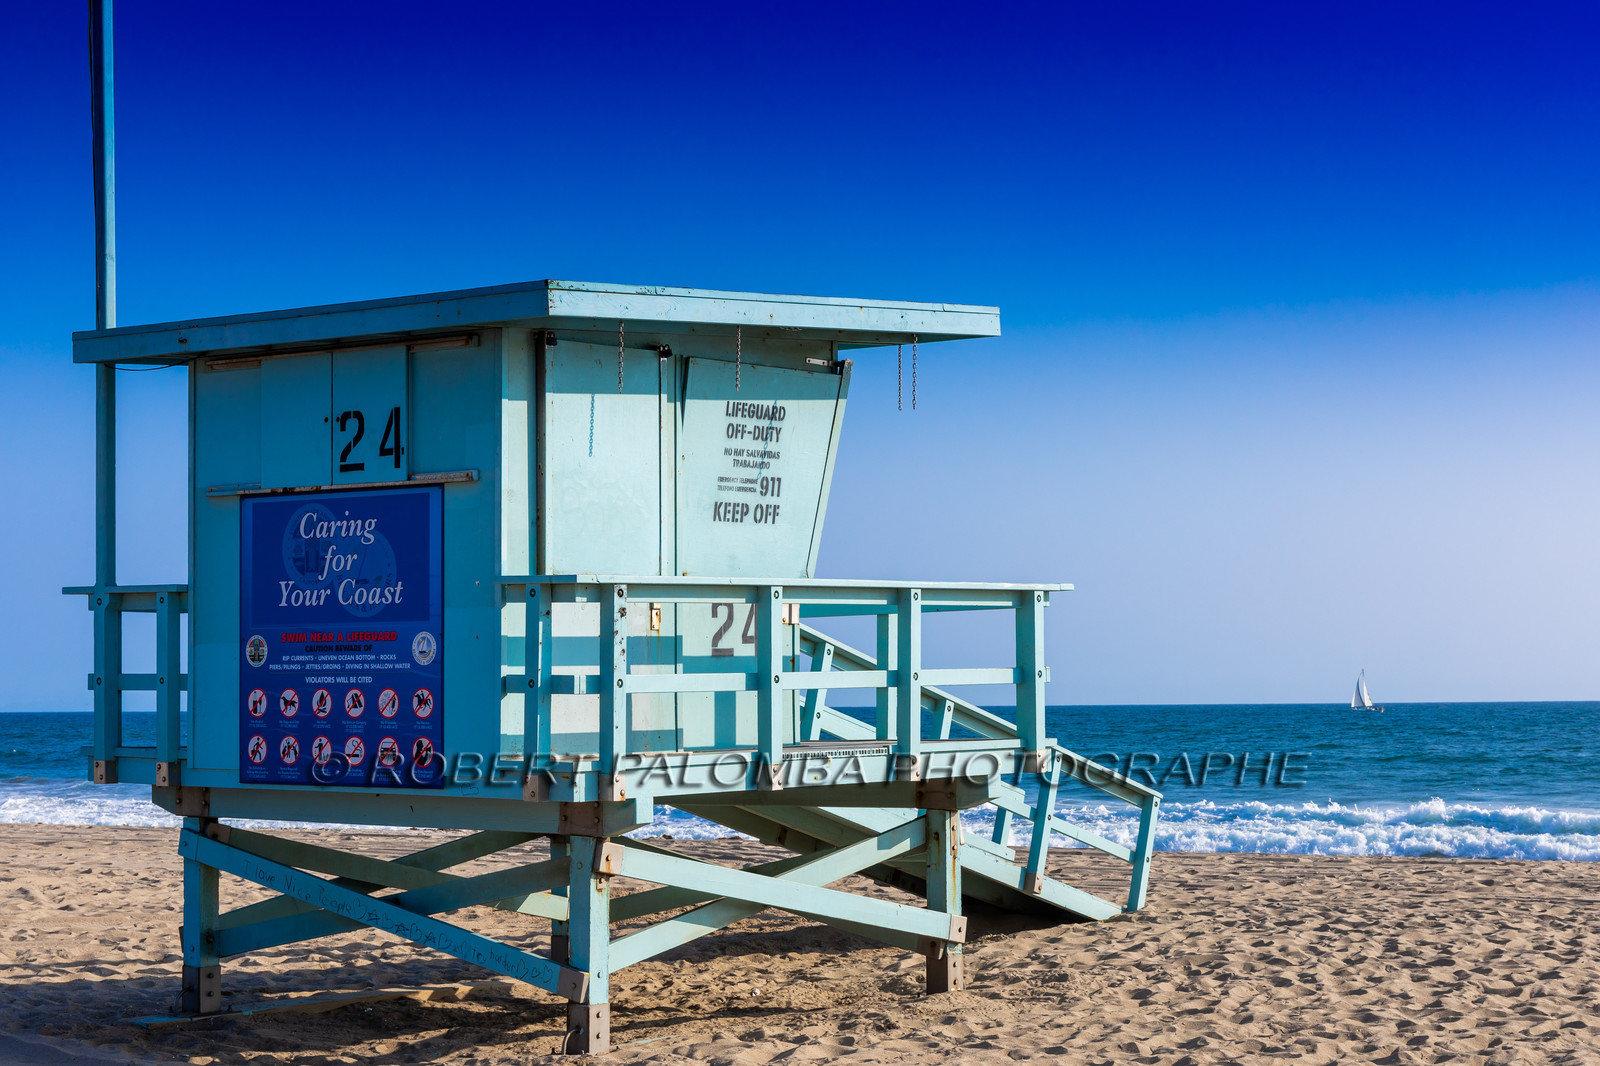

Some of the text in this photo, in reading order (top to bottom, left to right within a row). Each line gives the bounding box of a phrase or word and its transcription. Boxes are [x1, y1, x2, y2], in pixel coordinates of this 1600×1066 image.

[725, 400, 787, 422] LIFEGUARD
[339, 407, 404, 473] 24
[726, 422, 782, 443] OFF-DUTY
[723, 447, 781, 460] NO HAY SALVAVIDAS
[732, 459, 771, 470] TRABAJANDO
[760, 476, 782, 497] 911
[713, 501, 780, 525] KEEP OFF
[299, 510, 378, 545] Caring
[318, 545, 358, 581] for
[278, 580, 331, 607] Your
[337, 578, 404, 606] Coast
[281, 631, 398, 643] SWIM NEAR A LIFEGUARD
[304, 644, 373, 653] CAUTION BEWARE OF
[304, 676, 335, 684] VIOLATORS
